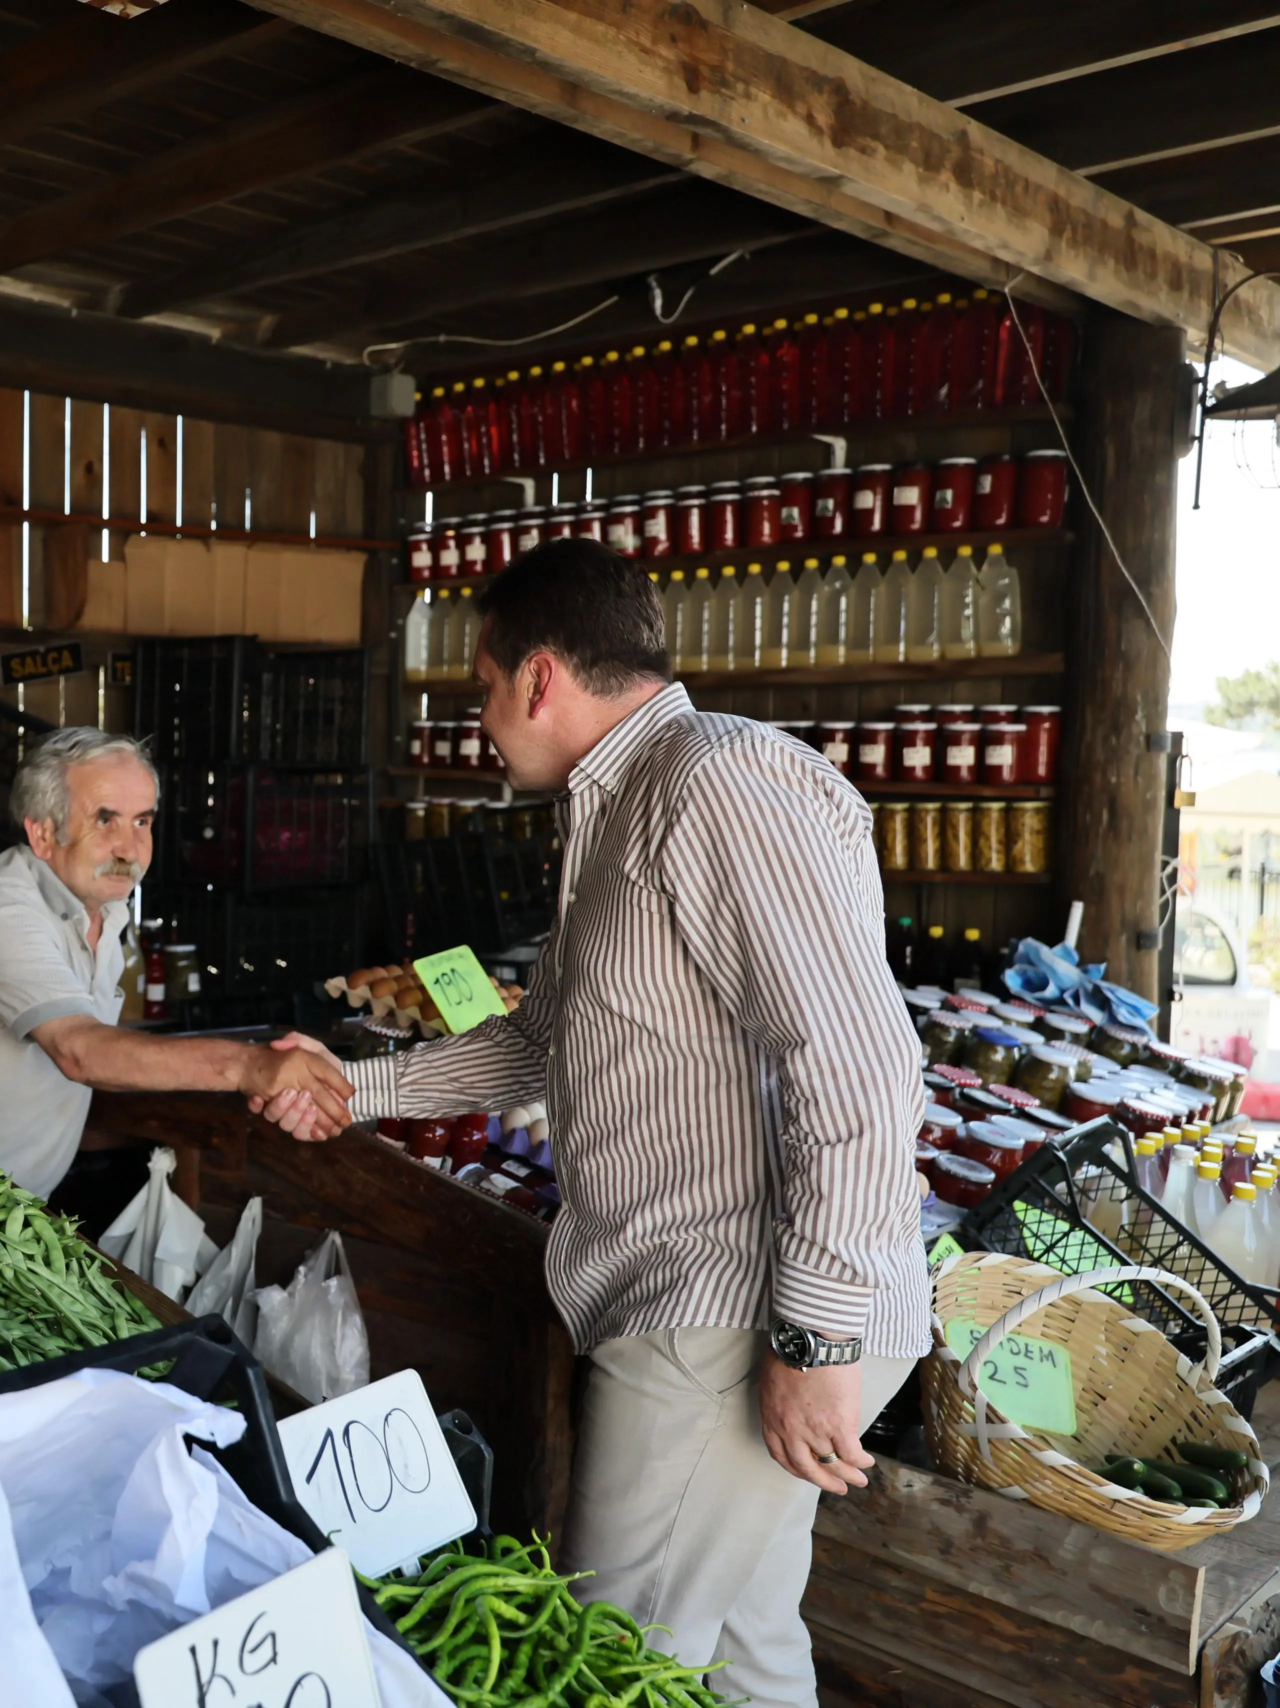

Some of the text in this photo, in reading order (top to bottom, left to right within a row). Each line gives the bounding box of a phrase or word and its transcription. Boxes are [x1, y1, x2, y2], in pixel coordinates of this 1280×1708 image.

[10, 648, 74, 680] SALÇA
[305, 1408, 431, 1524] 100
[188, 1611, 277, 1708] KG
